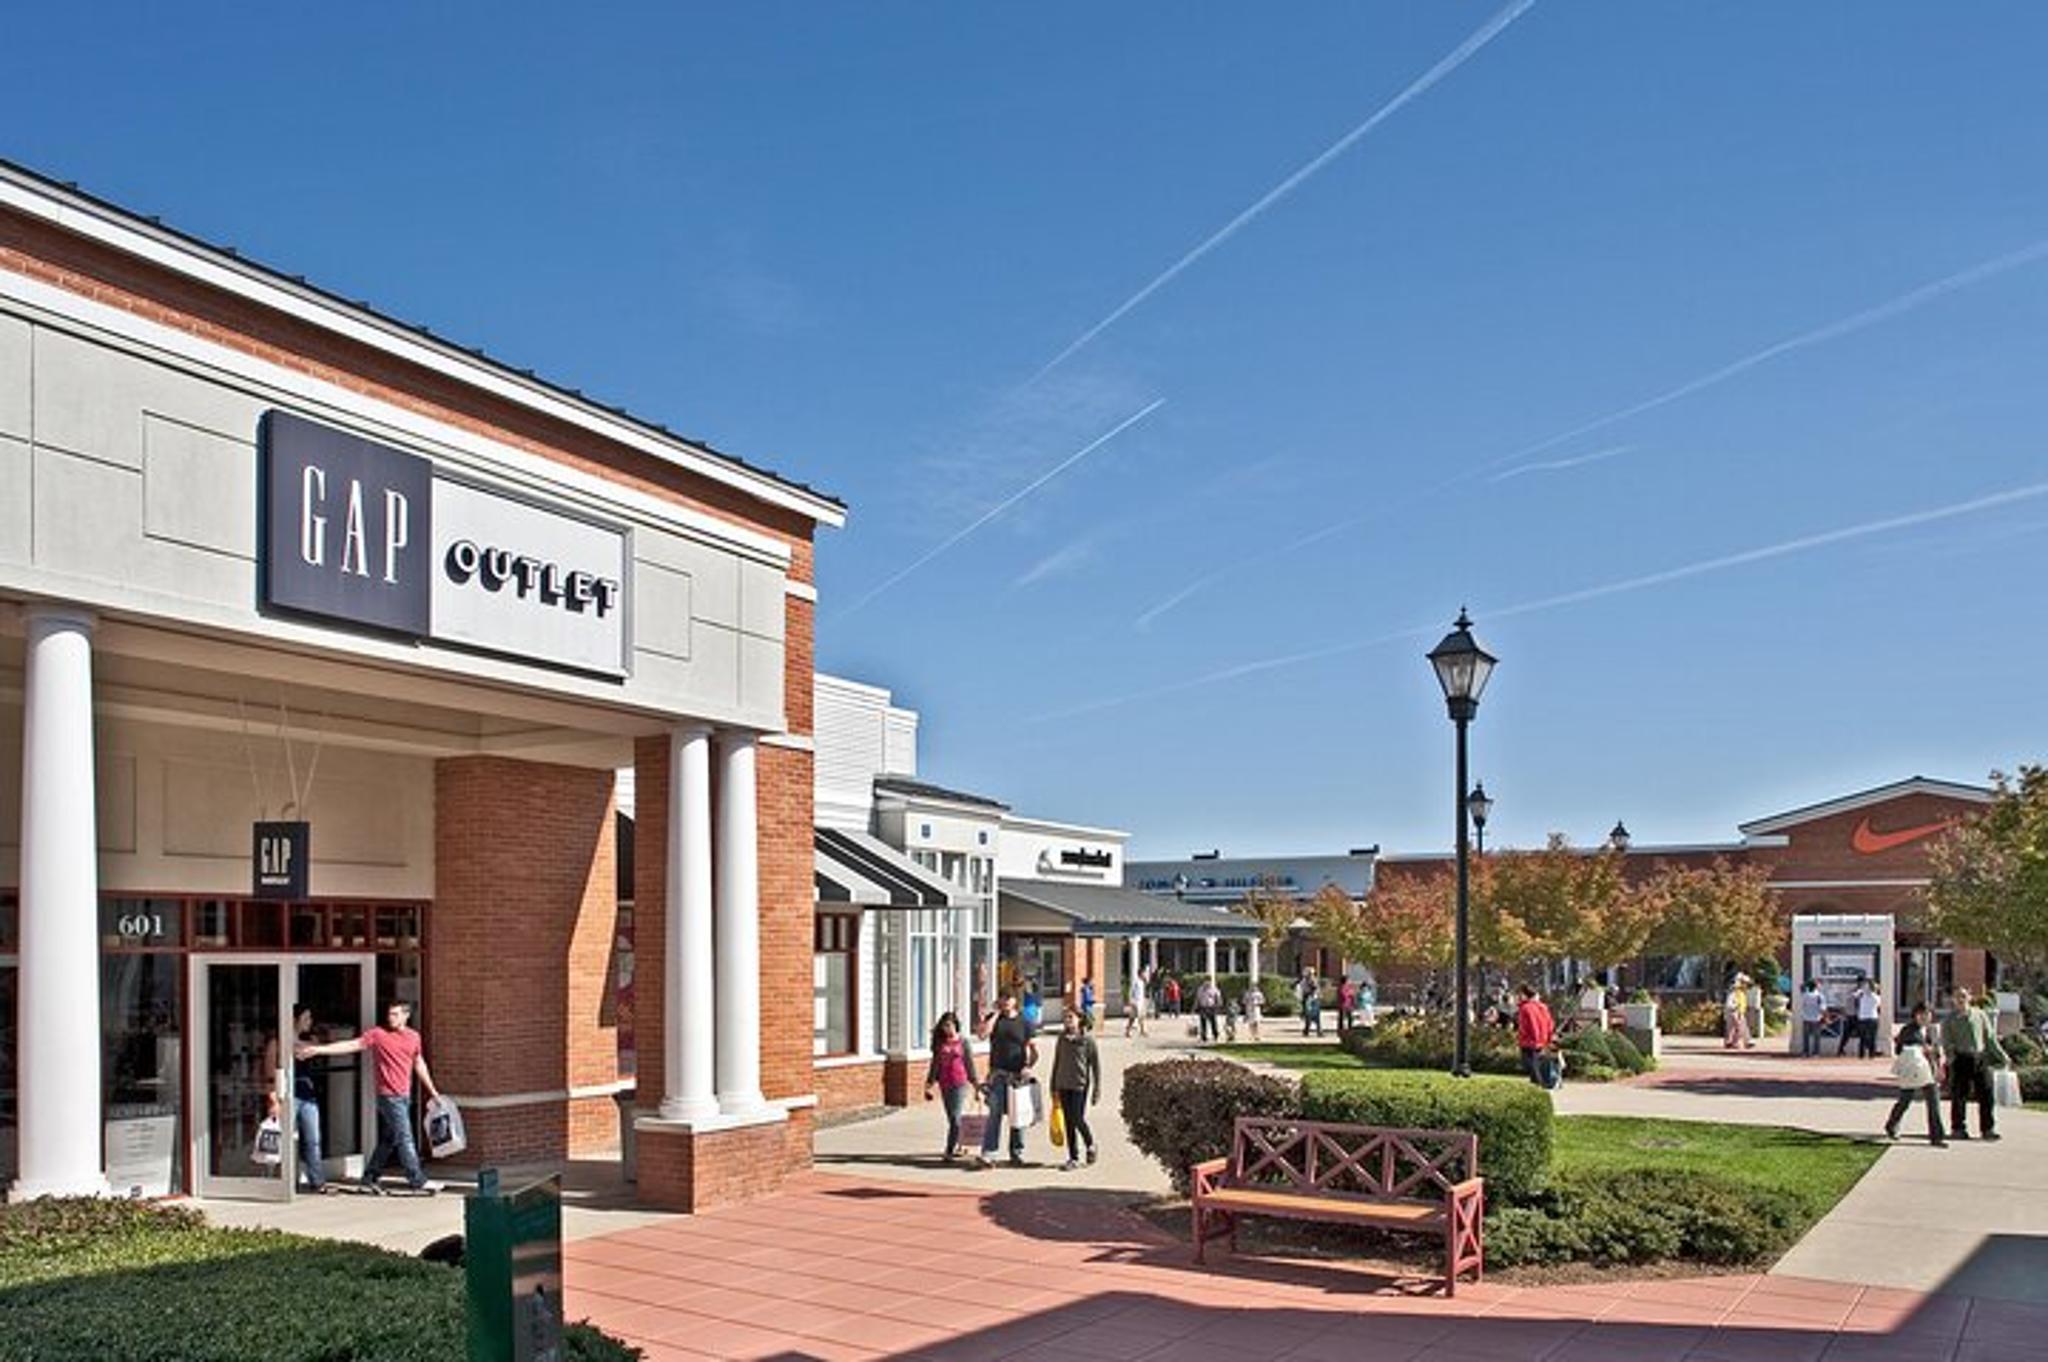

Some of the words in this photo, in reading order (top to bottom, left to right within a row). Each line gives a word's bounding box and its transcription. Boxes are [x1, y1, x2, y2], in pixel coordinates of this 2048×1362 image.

[302, 465, 408, 585] GAP
[445, 539, 619, 618] OUTLET
[261, 837, 291, 874] GAP
[118, 914, 165, 936] 601
